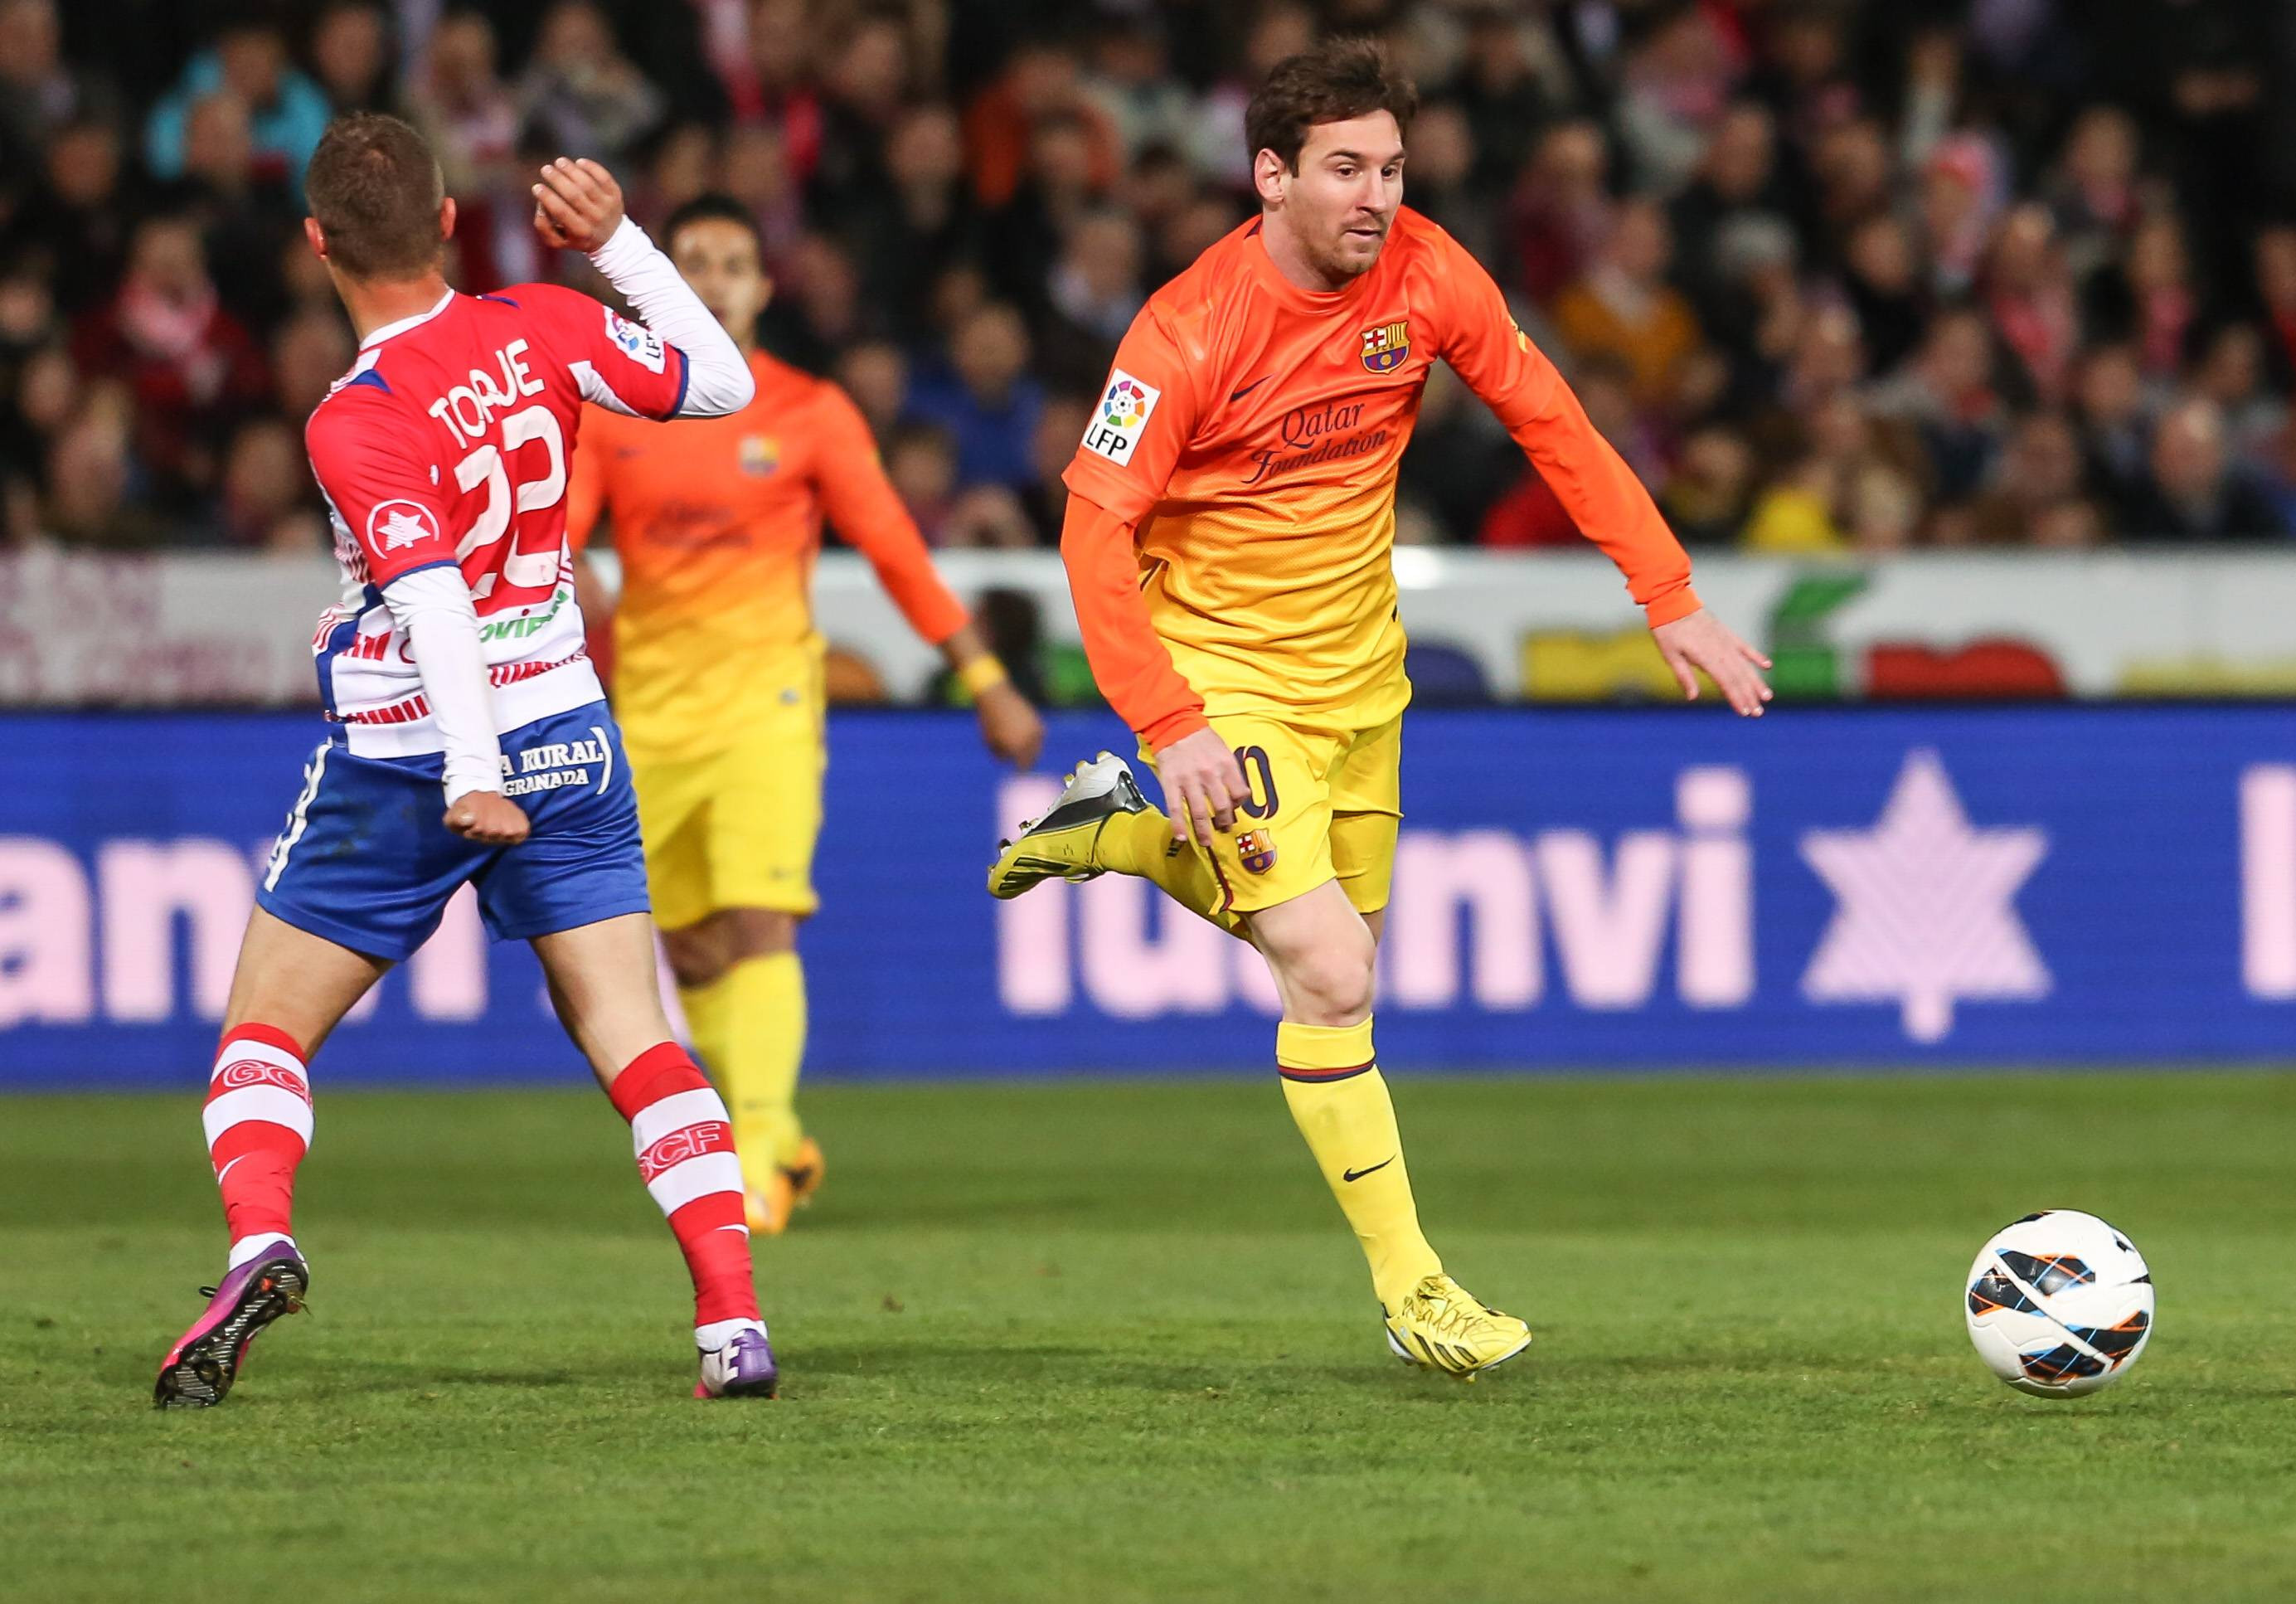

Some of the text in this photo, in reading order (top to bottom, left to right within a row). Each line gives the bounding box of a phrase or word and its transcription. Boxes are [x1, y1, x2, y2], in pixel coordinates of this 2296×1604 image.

[427, 338, 546, 450] TORJE
[1086, 423, 1128, 456] LFP
[1281, 403, 1366, 450] Qatar
[1240, 430, 1386, 484] Foundation
[453, 405, 568, 600] 22
[520, 740, 604, 773] RURAL
[502, 768, 589, 796] GRANADA
